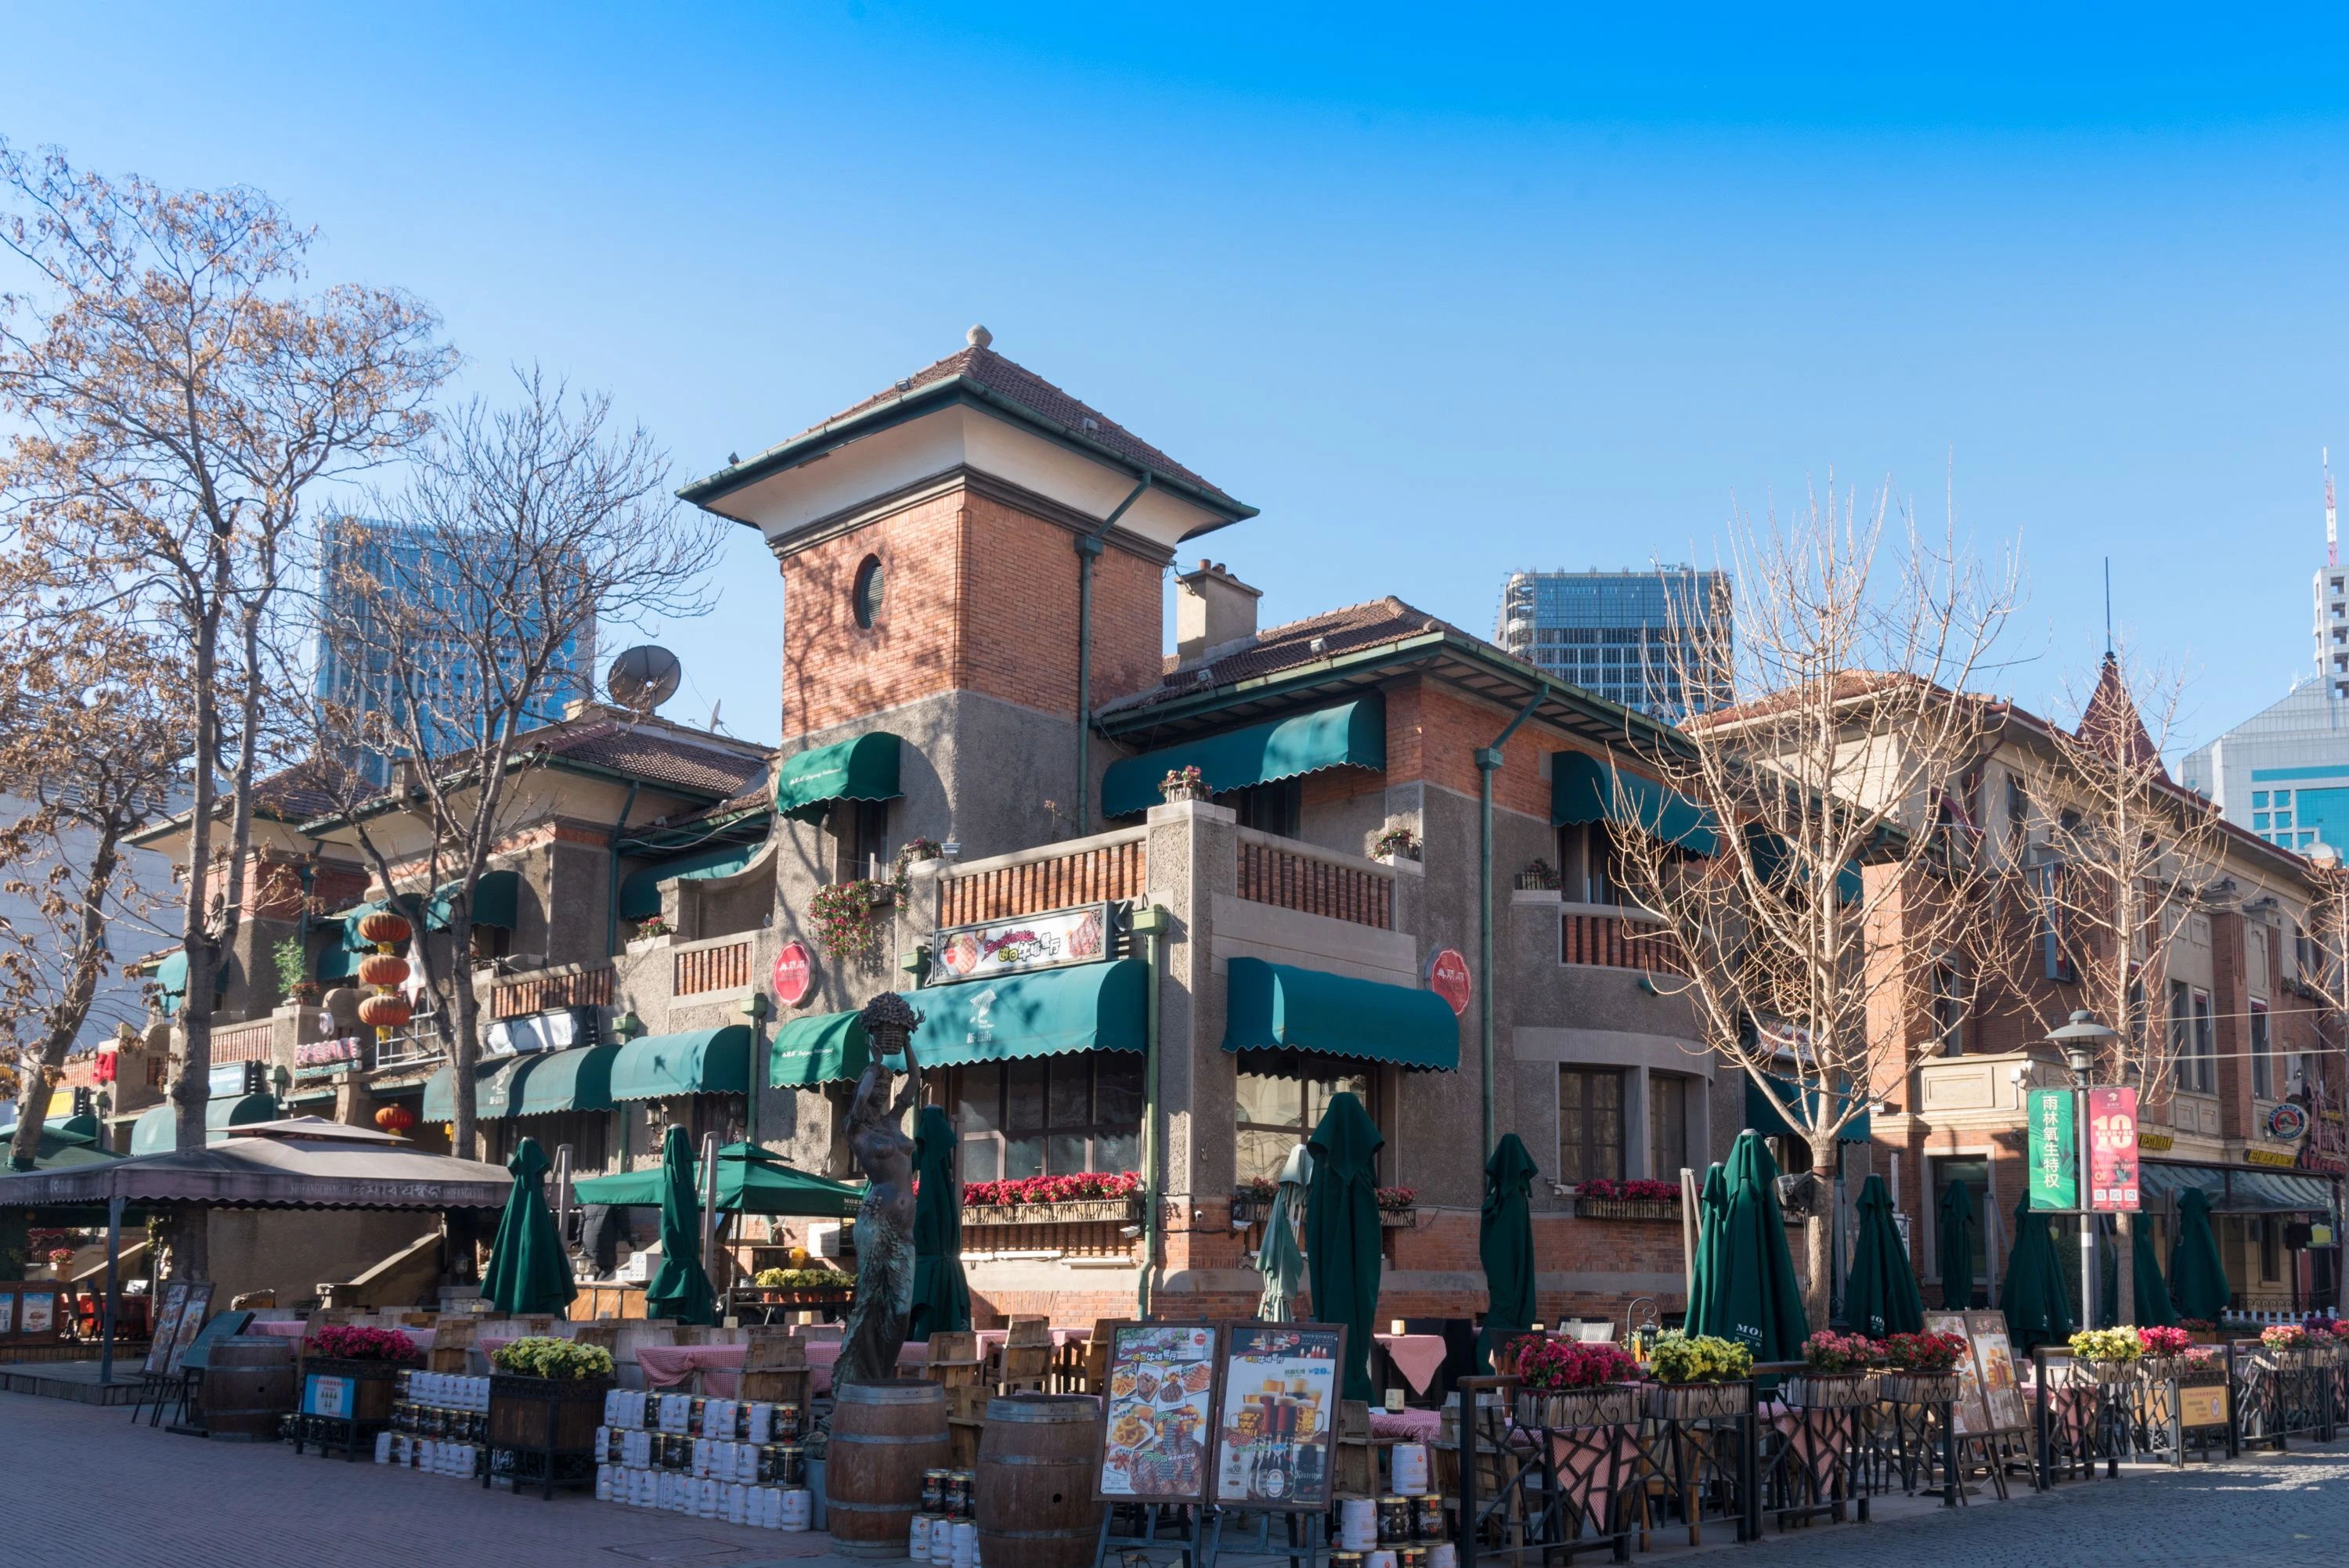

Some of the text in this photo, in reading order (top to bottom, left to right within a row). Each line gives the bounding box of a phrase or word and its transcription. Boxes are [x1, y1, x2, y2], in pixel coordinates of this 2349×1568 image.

[2042, 1095, 2060, 1188] 雨林氧生特权
[2095, 1172, 2106, 1181] OF
